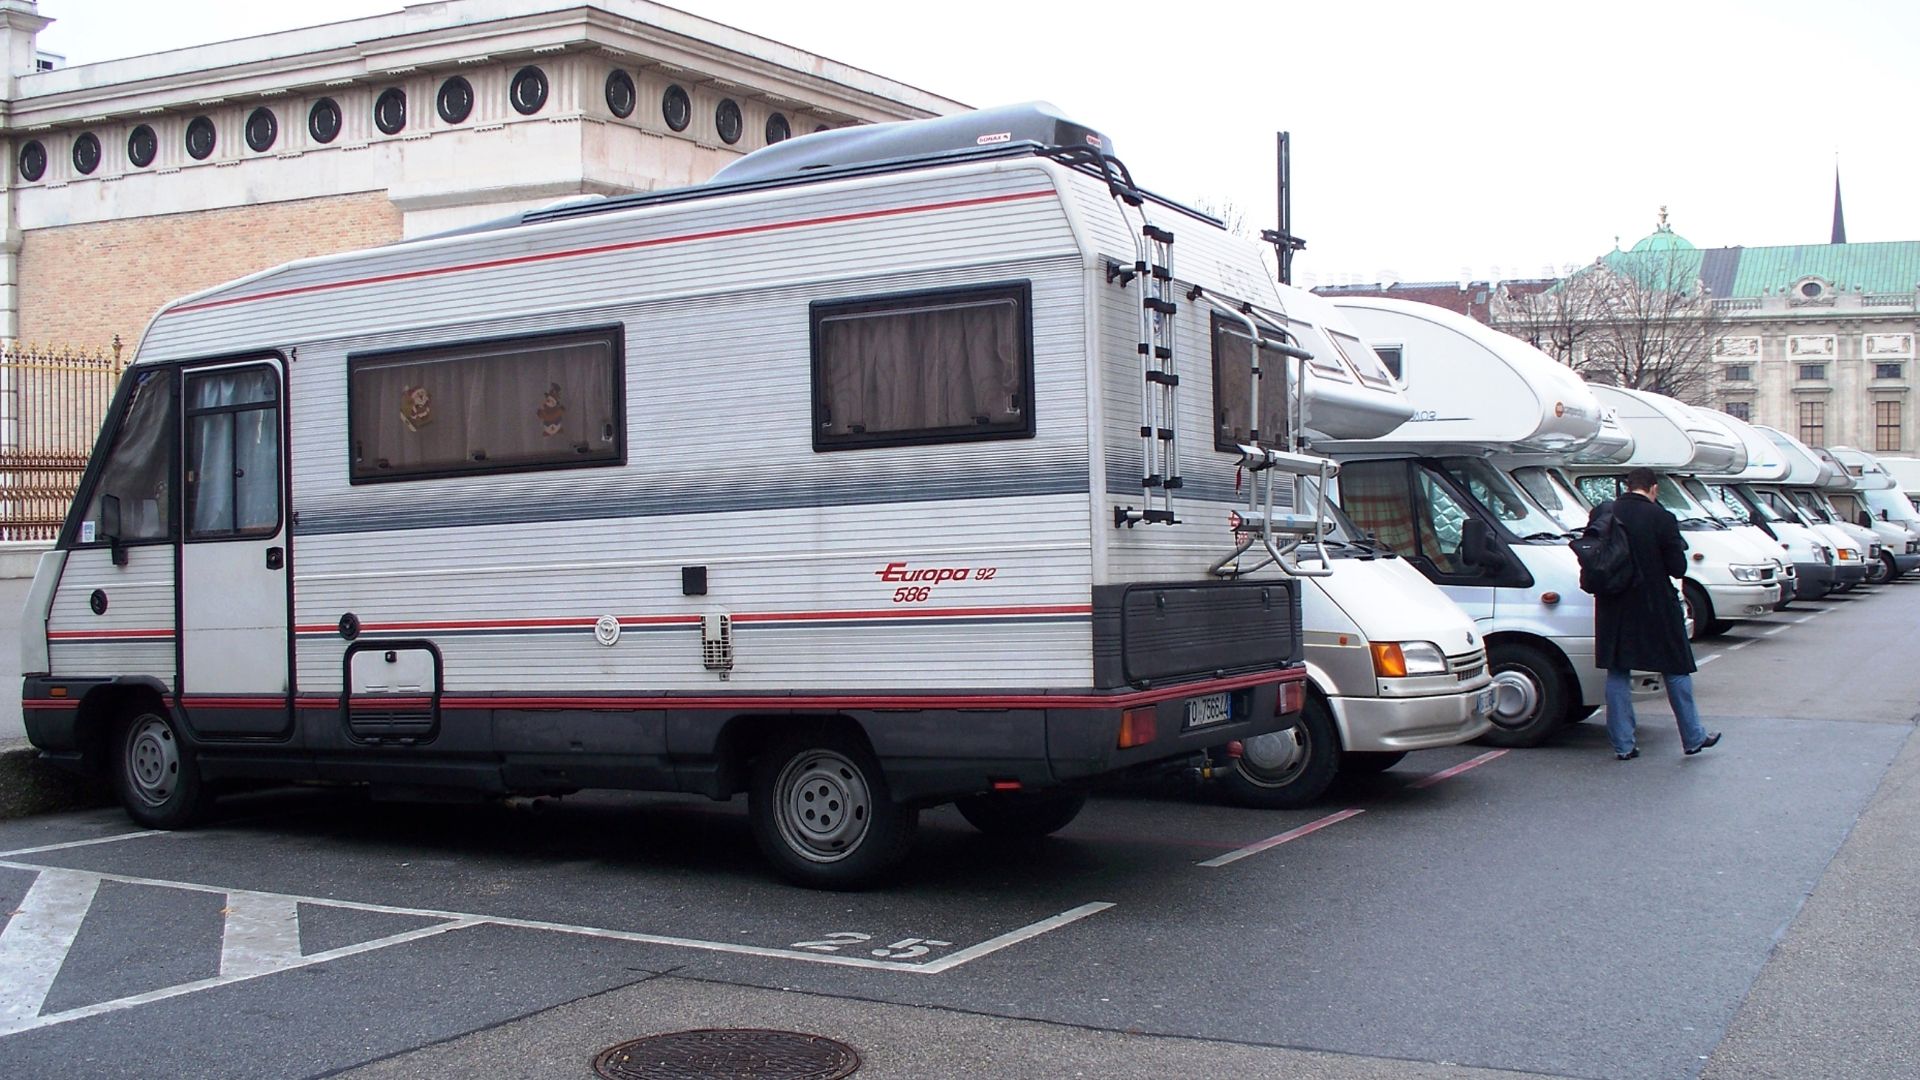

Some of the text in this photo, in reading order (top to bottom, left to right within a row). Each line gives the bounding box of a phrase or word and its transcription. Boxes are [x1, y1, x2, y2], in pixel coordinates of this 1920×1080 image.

[875, 562, 996, 584] Europa 92
[893, 587, 930, 602] 586
[790, 932, 952, 958] 25
